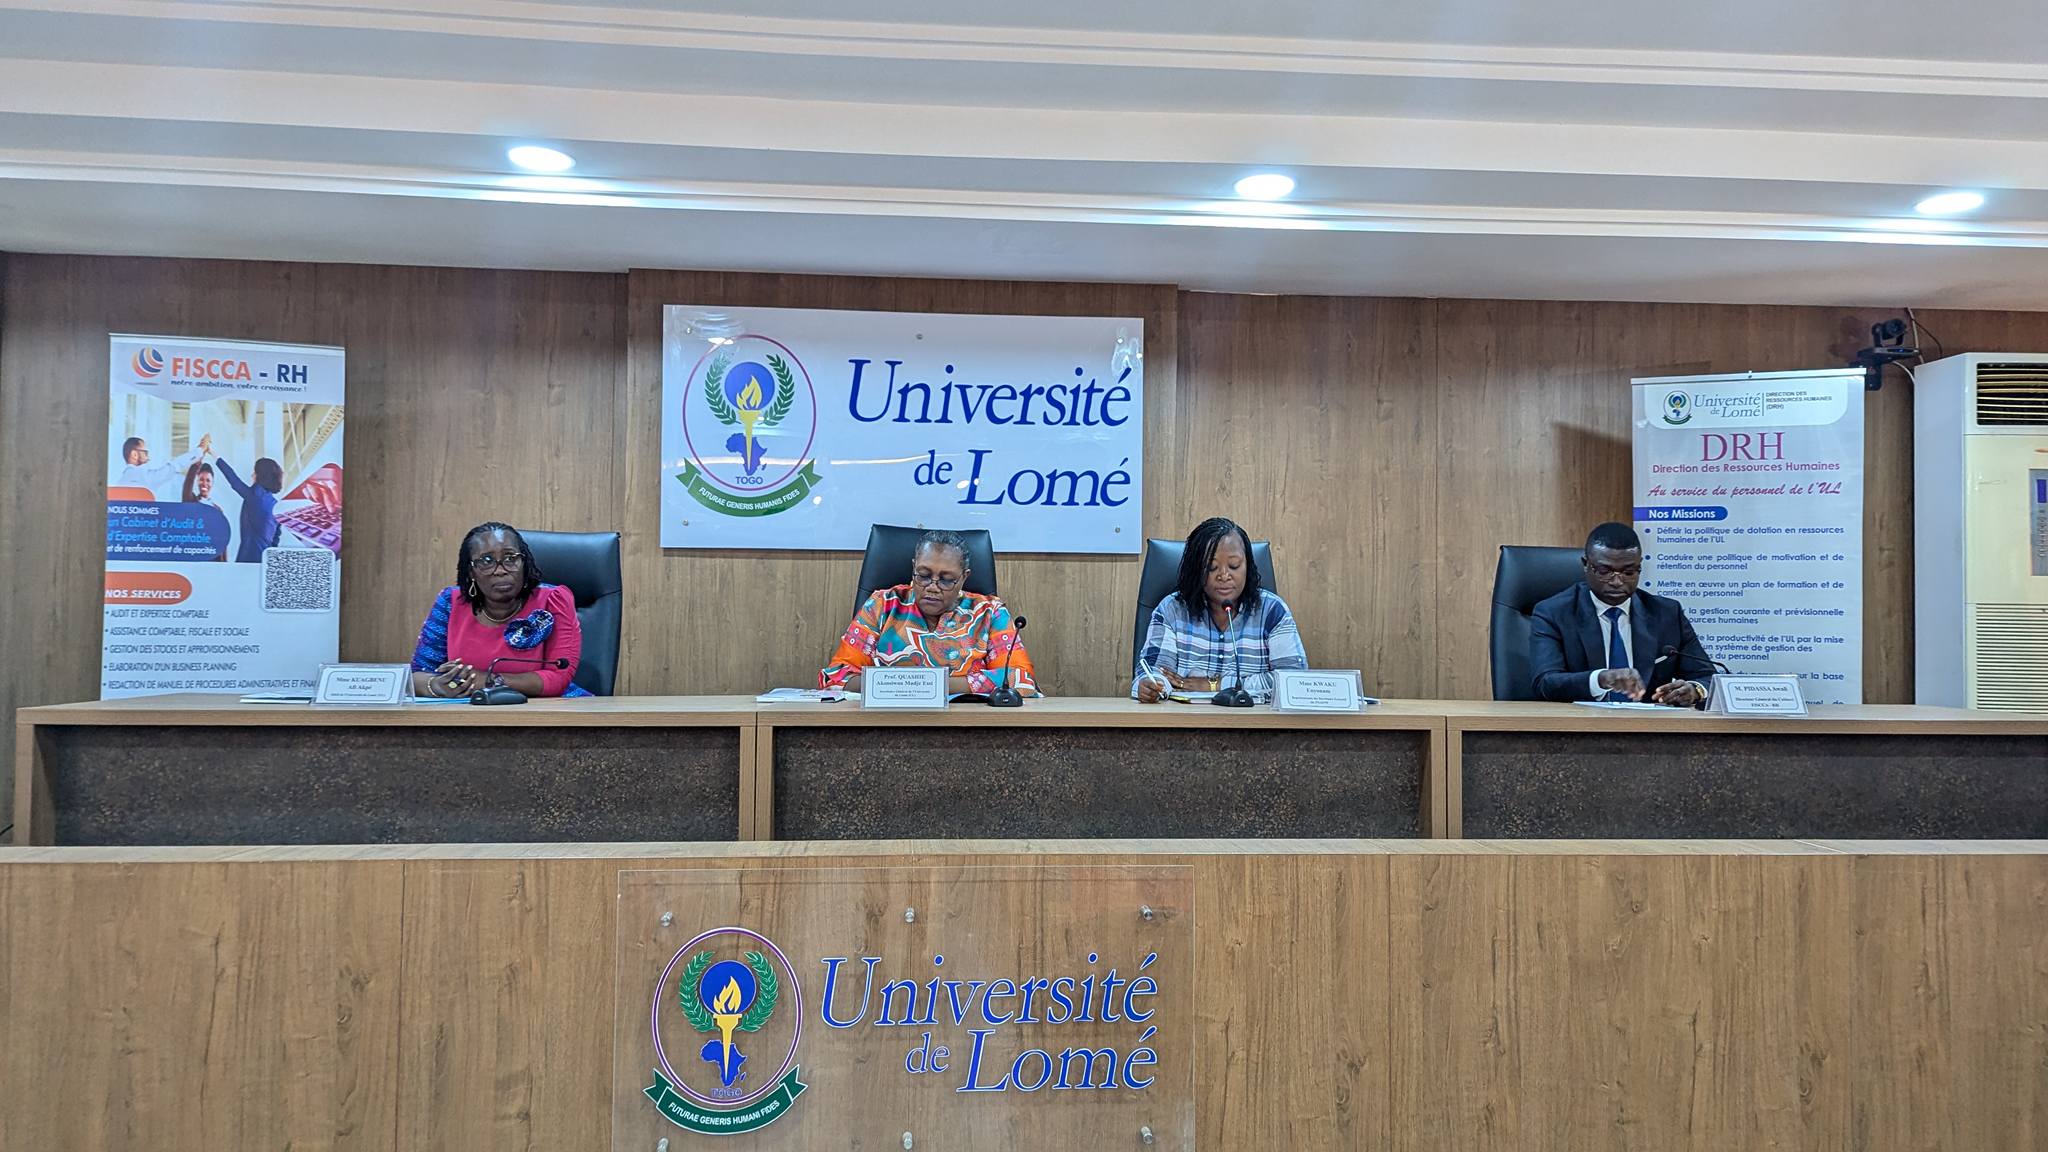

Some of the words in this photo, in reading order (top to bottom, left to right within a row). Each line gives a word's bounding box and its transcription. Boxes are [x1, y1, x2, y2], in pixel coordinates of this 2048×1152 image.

[172, 357, 252, 381] FISCCA
[277, 364, 308, 384] RH
[848, 359, 1132, 426] Université
[1694, 392, 1761, 408] Université
[1721, 406, 1761, 418] Lomé
[1700, 432, 1786, 462] DRH
[1653, 464, 1700, 474] Direction
[1703, 464, 1720, 473] des
[1724, 463, 1782, 472] Ressources
[1786, 462, 1840, 471] Humaines
[736, 476, 763, 484] TOGO
[914, 449, 953, 485] de
[958, 449, 1131, 506] Lomé
[1648, 486, 1665, 496] Au
[1673, 486, 1707, 496] service
[1714, 485, 1727, 496] du
[1730, 485, 1785, 498] personnel
[1789, 484, 1803, 495] de
[699, 487, 726, 506] FUTURAE
[726, 500, 754, 510] GENERIS
[755, 498, 783, 509] HUMANIS
[783, 489, 800, 502] FIDES
[108, 506, 127, 514] NOUS
[128, 506, 159, 514] SOMMES
[1648, 509, 1669, 519] Nos
[1672, 509, 1715, 519] Missions
[122, 516, 158, 528] Cabinet
[161, 517, 195, 529] d'Audit
[196, 519, 204, 529] &
[1694, 527, 1730, 536] politique
[1733, 526, 1744, 534] de
[1747, 526, 1782, 534] dotation
[108, 530, 158, 543] d'Expertise
[160, 532, 211, 544] Comptable
[1657, 536, 1697, 544] humaines
[1700, 536, 1709, 544] de
[114, 544, 123, 552] de
[125, 544, 172, 554] renforcement
[173, 545, 182, 554] de
[184, 546, 217, 556] capacités
[1657, 553, 1694, 561] Conduire
[1717, 553, 1753, 563] politique
[1657, 562, 1692, 570] rétention
[1694, 562, 1705, 570] du
[1706, 562, 1748, 572] personnel
[1657, 580, 1682, 588] Mettre
[1742, 581, 1760, 590] plan
[105, 589, 128, 598] NOS
[131, 590, 182, 599] SERVICES
[1657, 589, 1688, 597] carrière
[1703, 589, 1744, 598] personnel
[110, 609, 129, 618] AUDIT
[130, 609, 138, 618] ET
[139, 609, 171, 618] EXPERTISE
[172, 609, 210, 618] COMPTABLE
[1700, 608, 1730, 617] gestion
[1733, 608, 1770, 616] courante
[1774, 608, 1783, 616] et
[1785, 608, 1844, 618] prévisionnelle
[1718, 616, 1759, 624] humaines
[110, 627, 147, 636] ASSISTANCE
[188, 627, 213, 636] FISCALE
[214, 628, 221, 636] ET
[223, 628, 250, 636] SOCIALE
[1717, 634, 1766, 643] productivité
[109, 644, 139, 653] GESTION
[140, 644, 152, 653] DES
[153, 644, 178, 654] STOCKS
[179, 645, 186, 653] ET
[187, 645, 260, 654] APPROVISIONNEMENTS
[1715, 643, 1748, 652] système
[1765, 644, 1794, 653] gestion
[1728, 653, 1769, 662] personnel
[108, 662, 153, 671] ELABORATION
[172, 662, 202, 671] BUSINESS
[203, 662, 237, 671] PLANNING
[1811, 672, 1819, 680] la
[1823, 672, 1844, 680] base
[108, 680, 145, 689] REDACTION
[146, 680, 156, 689] DE
[157, 680, 183, 689] MANUEL
[185, 680, 194, 689] DE
[196, 680, 236, 689] PROCEDURES
[291, 680, 299, 688] ET
[821, 952, 1158, 1028] Université
[905, 1032, 951, 1074] de
[956, 1026, 1158, 1093] Lomé
[711, 1088, 742, 1098] TOGO
[669, 1102, 699, 1122] FUTURAE
[700, 1115, 731, 1125] GENERIS
[733, 1112, 760, 1124] HUMANI
[761, 1100, 780, 1116] FIDES
